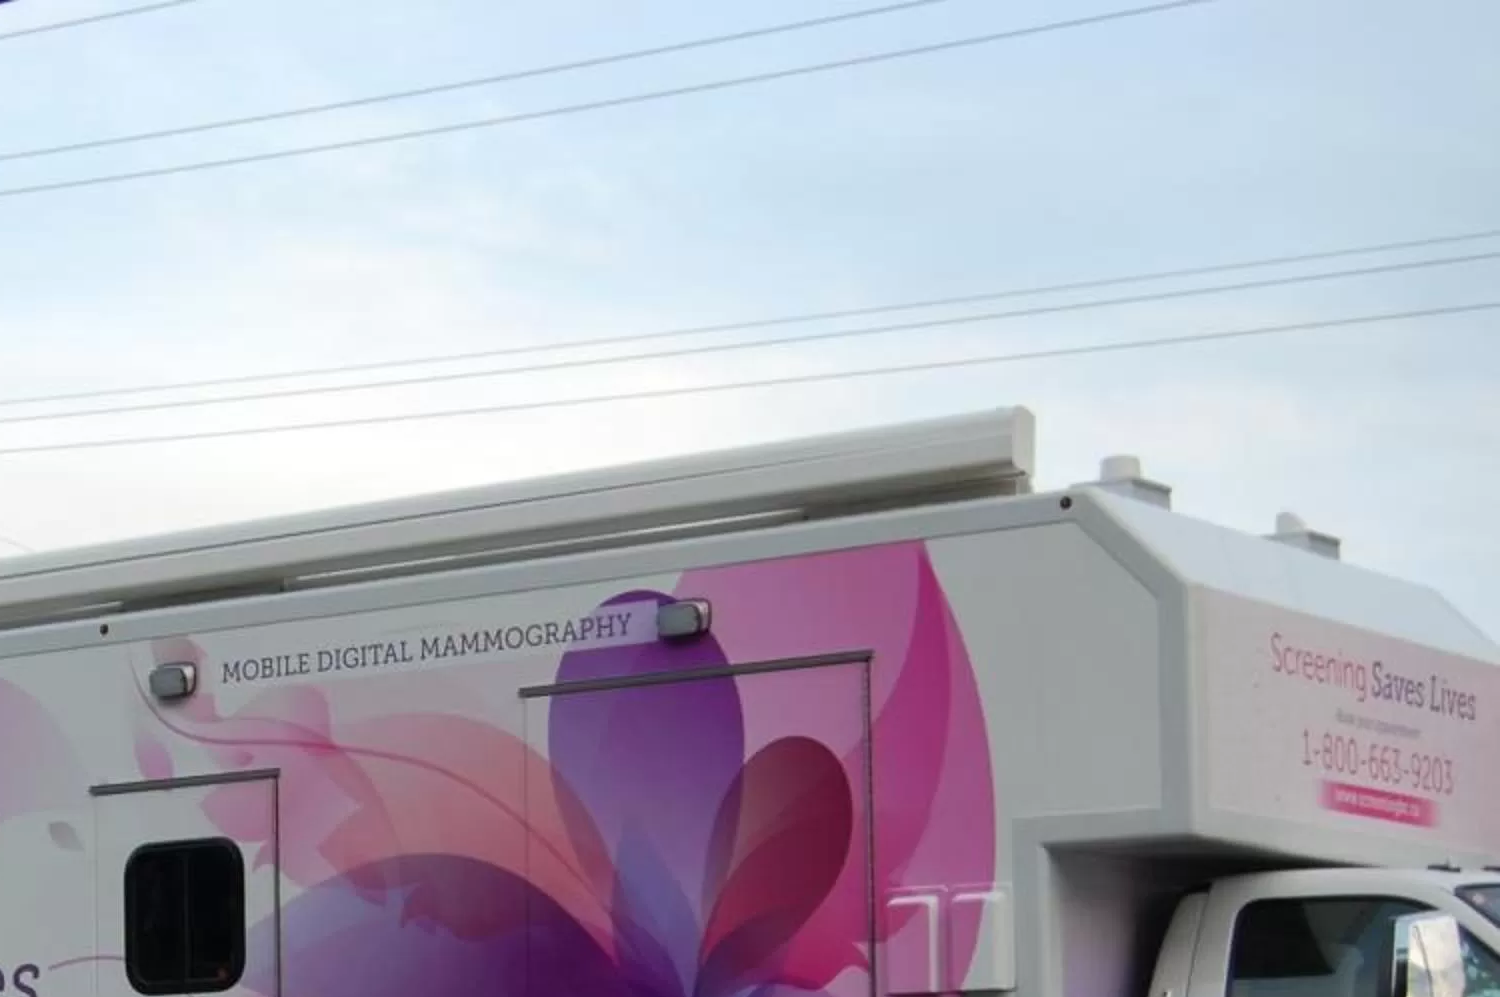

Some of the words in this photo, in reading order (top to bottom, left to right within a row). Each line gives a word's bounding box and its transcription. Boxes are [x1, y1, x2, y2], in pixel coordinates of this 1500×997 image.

[222, 652, 310, 684] MOBILE
[316, 640, 413, 673] DIGITAL
[419, 612, 633, 661] MAMMOGRAPHY
[1270, 632, 1366, 702] Screening
[1371, 661, 1424, 709] Saves
[1430, 675, 1476, 720] Lives
[1302, 729, 1455, 795] 1-800-663-9203
